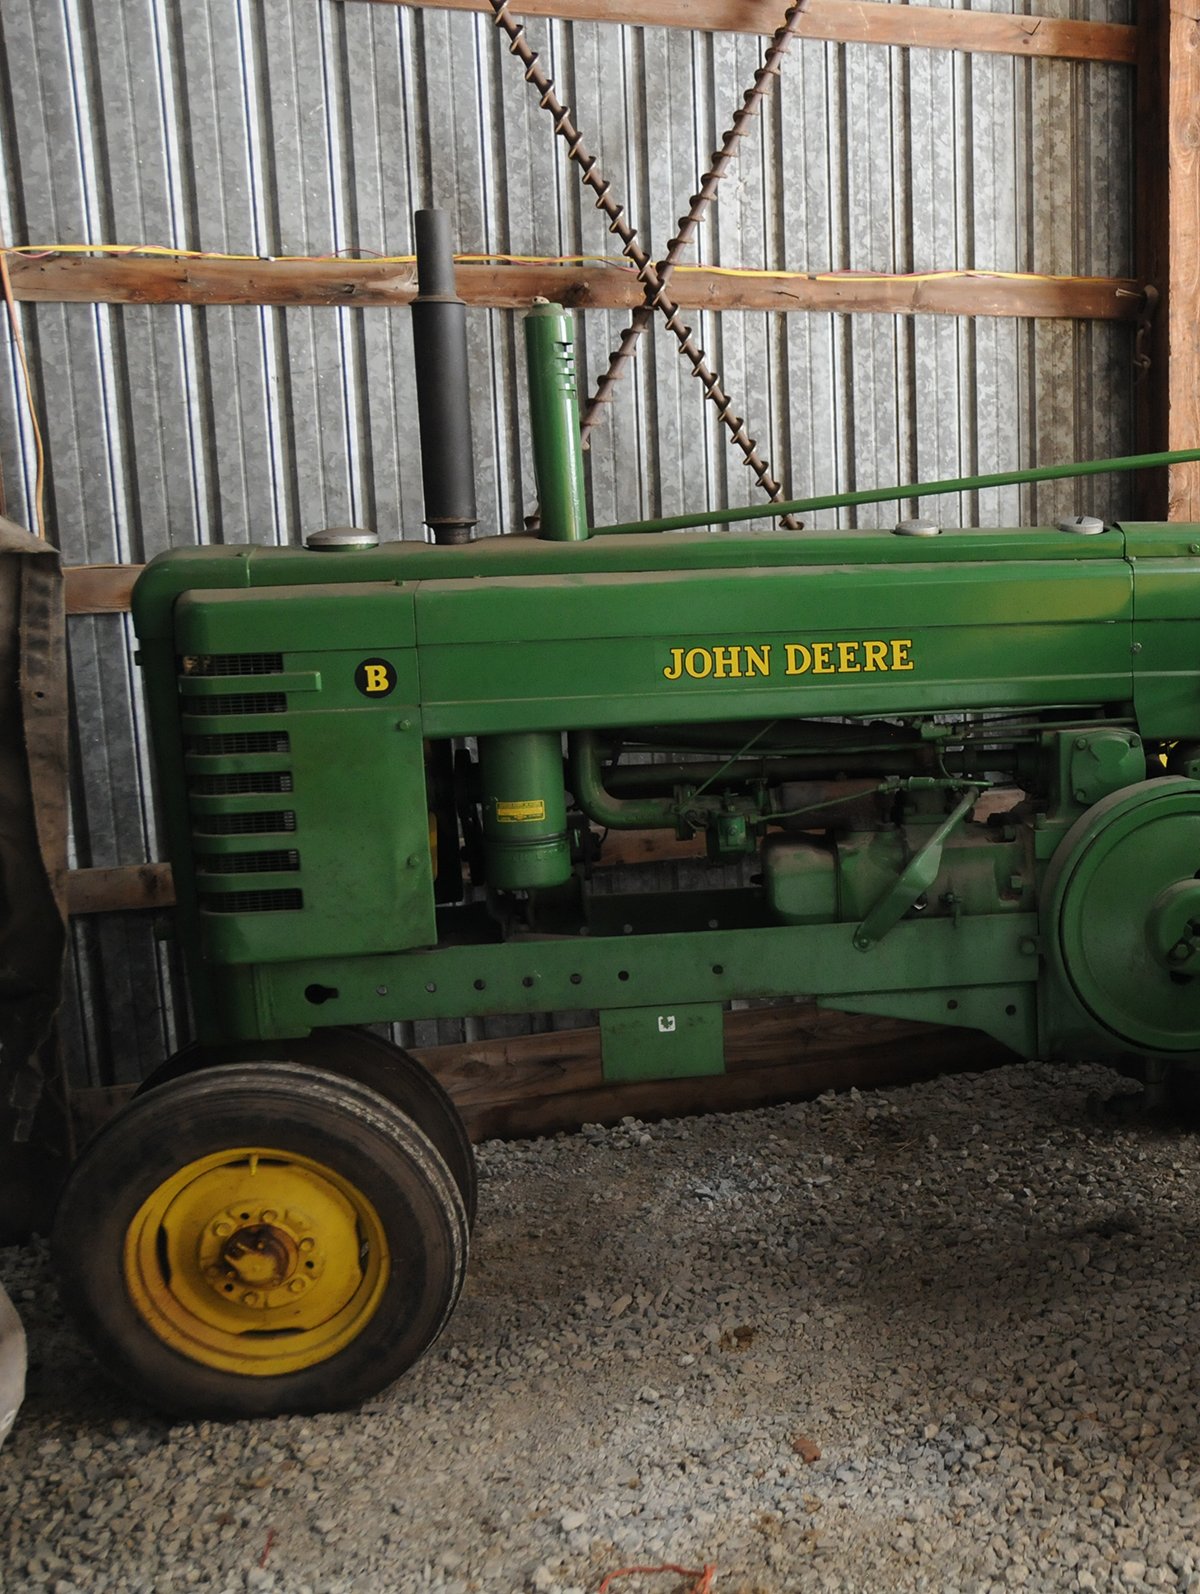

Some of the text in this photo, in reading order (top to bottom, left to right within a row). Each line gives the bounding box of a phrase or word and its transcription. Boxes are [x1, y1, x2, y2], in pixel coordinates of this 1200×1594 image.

[663, 639, 914, 680] JOHN DEERE
[364, 665, 389, 692] B
